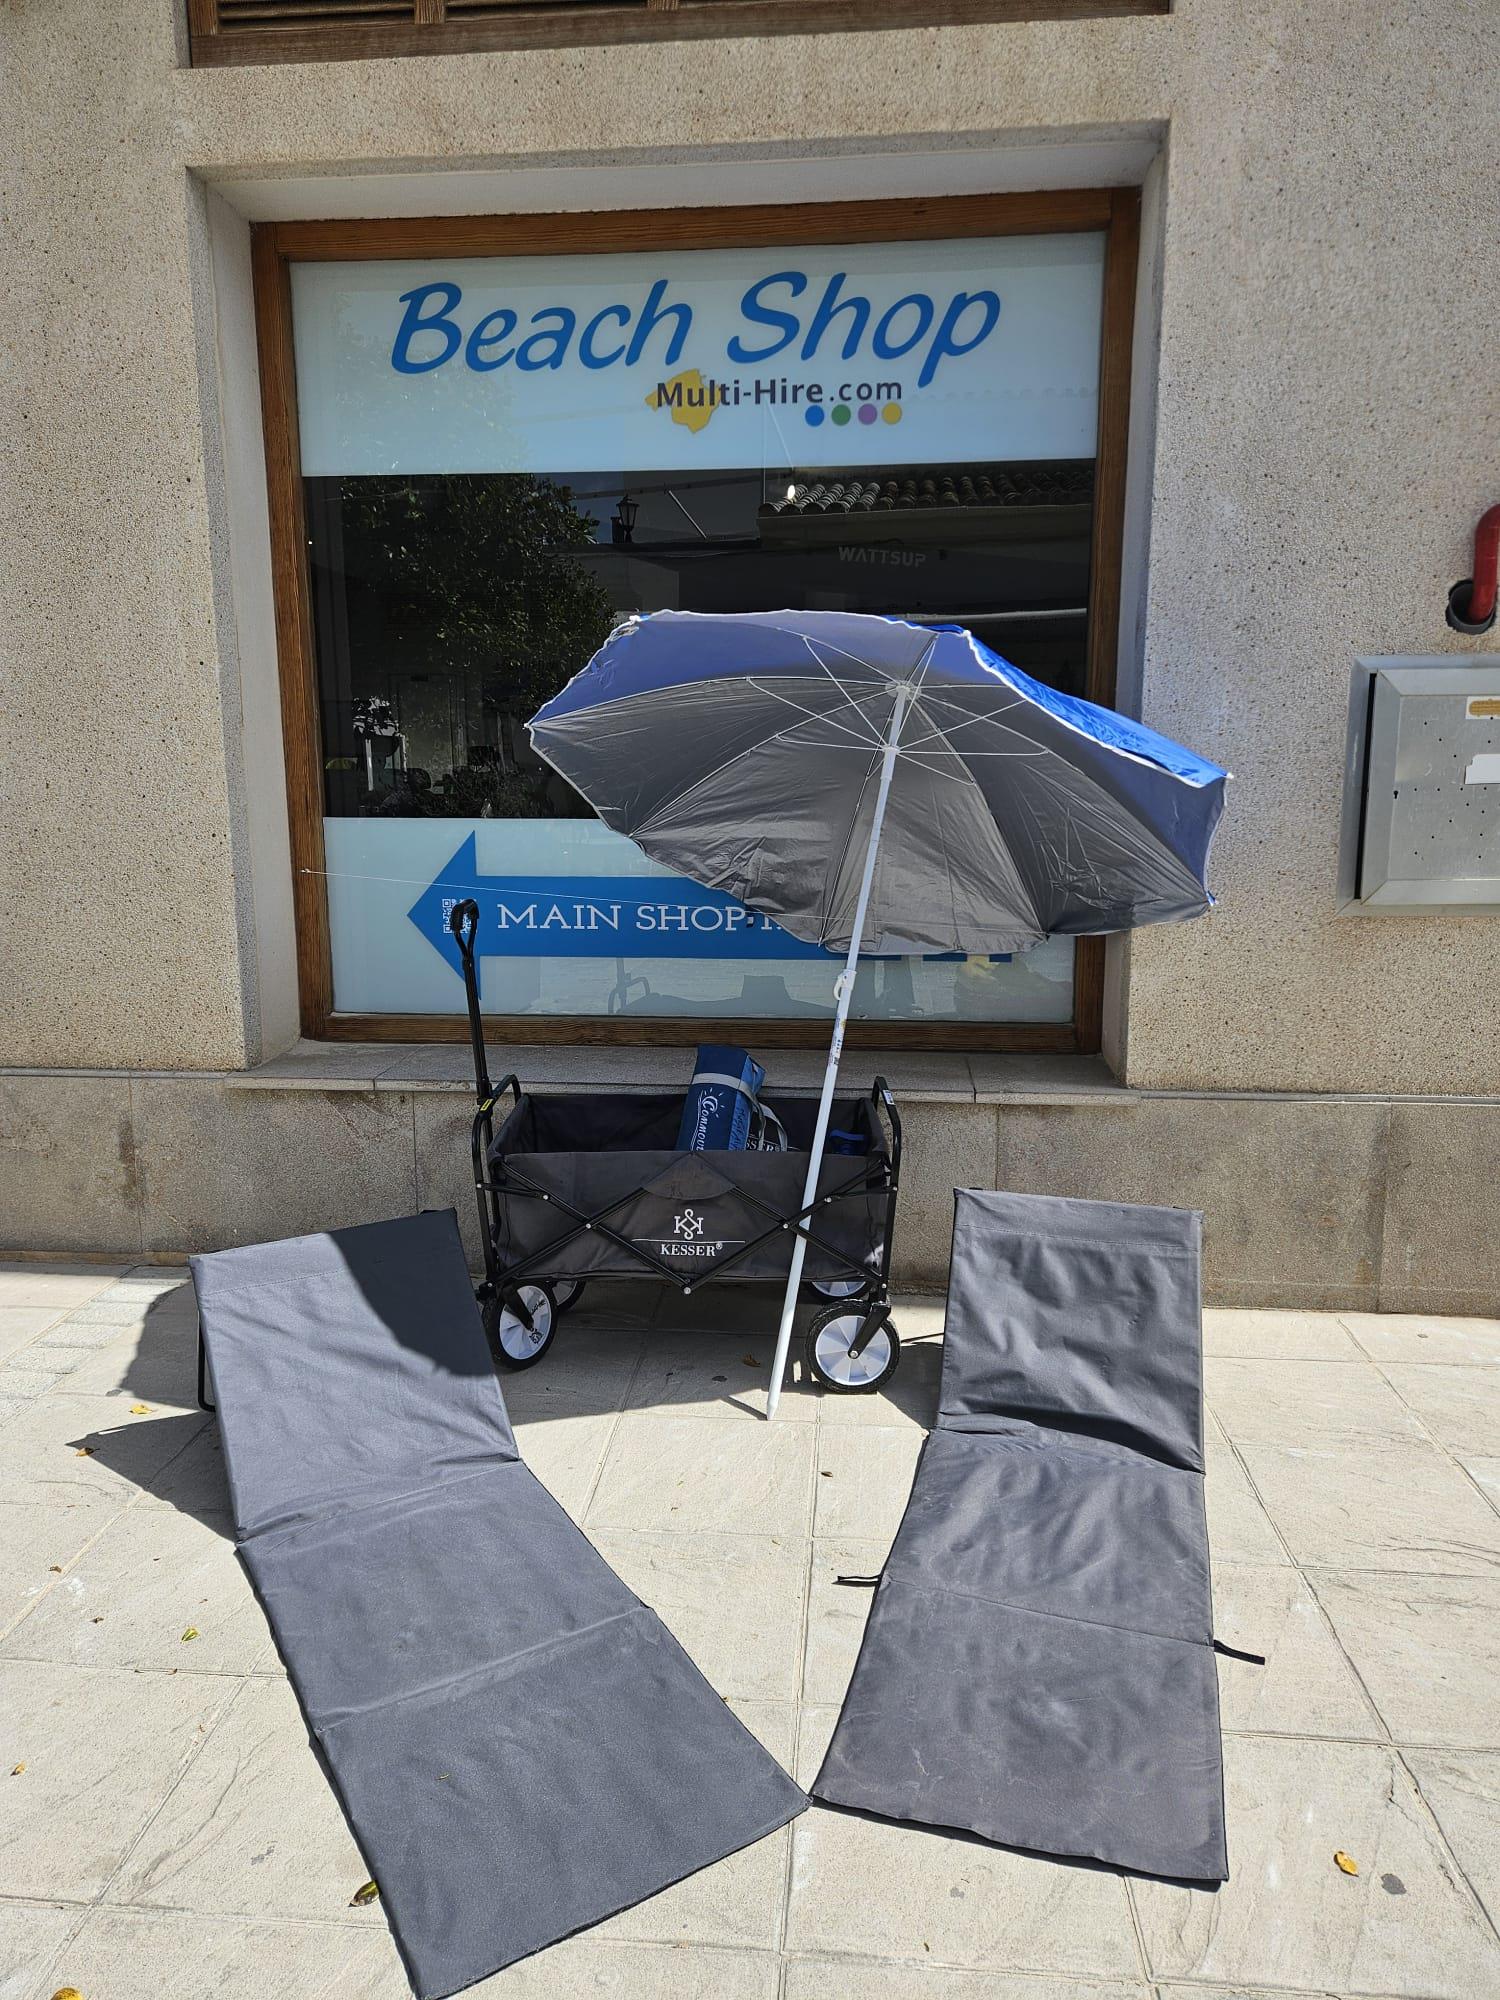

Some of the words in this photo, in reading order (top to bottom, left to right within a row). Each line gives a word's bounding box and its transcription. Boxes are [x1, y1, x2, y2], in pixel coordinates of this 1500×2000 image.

[390, 279, 693, 375] Beach
[726, 270, 1002, 389] Shop
[656, 378, 902, 408] Multi-Hire.com
[838, 546, 927, 568] WATTSUP
[497, 903, 621, 930] MAIN
